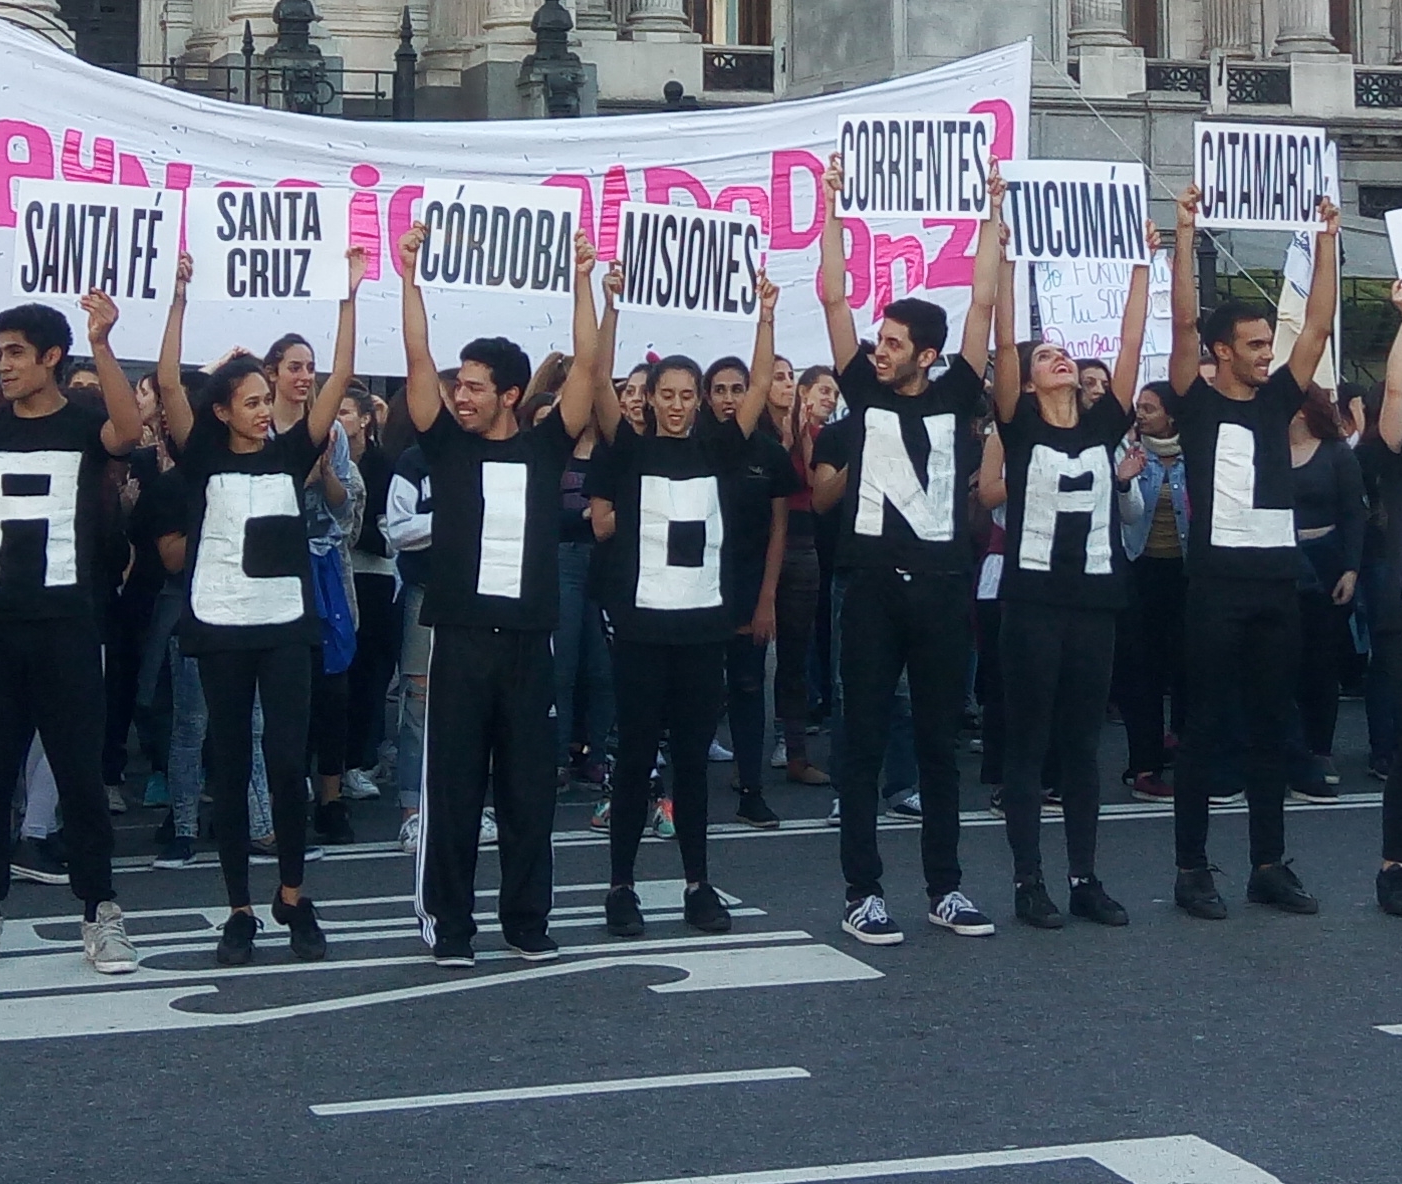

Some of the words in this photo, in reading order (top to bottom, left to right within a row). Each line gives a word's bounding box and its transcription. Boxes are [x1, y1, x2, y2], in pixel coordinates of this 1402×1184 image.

[215, 190, 322, 242] SANTA
[841, 119, 987, 212] CORRIENTES
[1007, 165, 1146, 260] TUCUMÁN
[1200, 130, 1324, 223] CATAMARCA
[20, 200, 123, 298] SANTA
[125, 190, 165, 300] FÉ
[226, 247, 312, 299] CRUZ
[420, 183, 573, 293] CÓRDOBA
[622, 212, 758, 315] MISIONES
[853, 406, 956, 542] N
[1018, 442, 1114, 575] A
[1210, 421, 1296, 548] L
[190, 472, 305, 626] C
[635, 474, 723, 610] O
